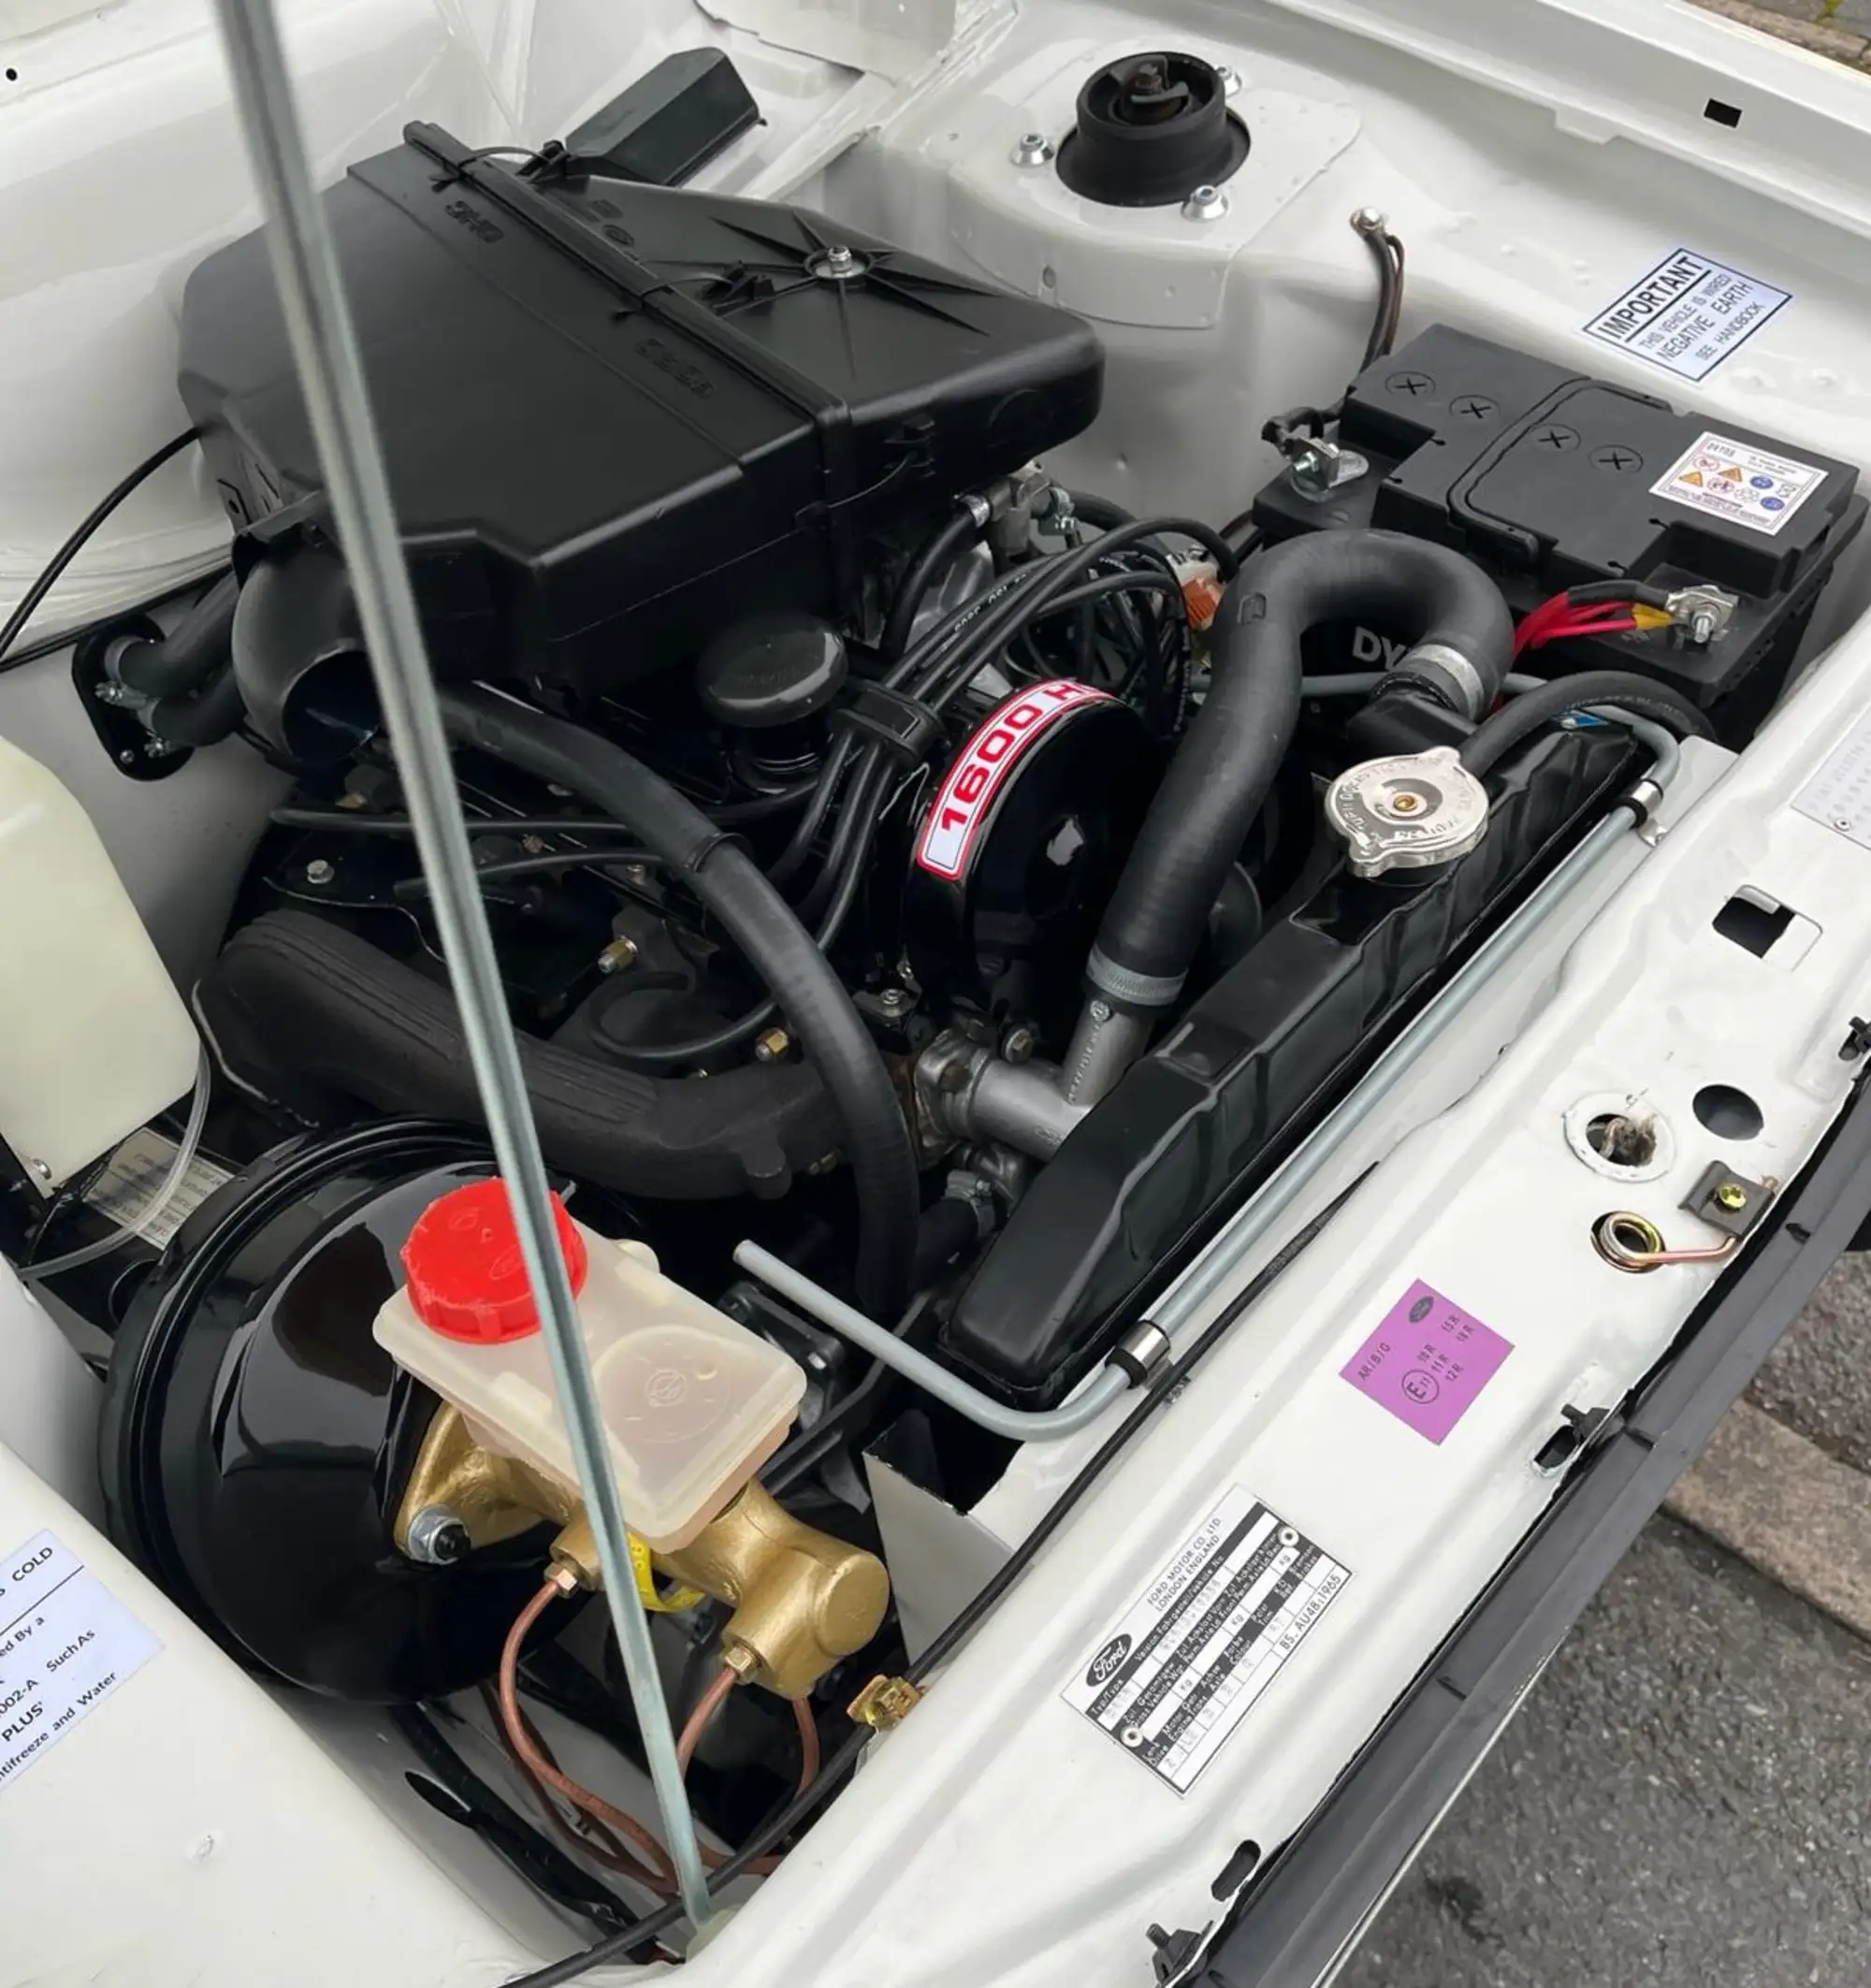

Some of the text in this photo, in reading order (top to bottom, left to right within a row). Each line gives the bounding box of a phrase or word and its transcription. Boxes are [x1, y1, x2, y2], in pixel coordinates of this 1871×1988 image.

[1598, 255, 1702, 338] IMPORTANT
[1656, 280, 1753, 360] NEGATIVE EARTH
[1637, 331, 1665, 349] THIS
[1658, 303, 1697, 333] VEHICLE
[1694, 300, 1764, 360] SEE HANDBOOK
[1353, 626, 1407, 672] DY
[941, 704, 1043, 831] 1600
[11, 1546, 53, 1583] COLD
[1146, 1580, 1168, 1605] FORD
[1166, 1549, 1194, 1580] MOTOR
[1154, 1574, 1187, 1612] LONDON
[1184, 1534, 1220, 1574] ENGLAND
[14, 1625, 32, 1642] By
[36, 1617, 45, 1626] a
[47, 1643, 79, 1673] Such
[78, 1629, 96, 1648] As
[1086, 1636, 1127, 1681] Ford
[51, 1707, 76, 1732] and
[77, 1671, 118, 1707] Water
